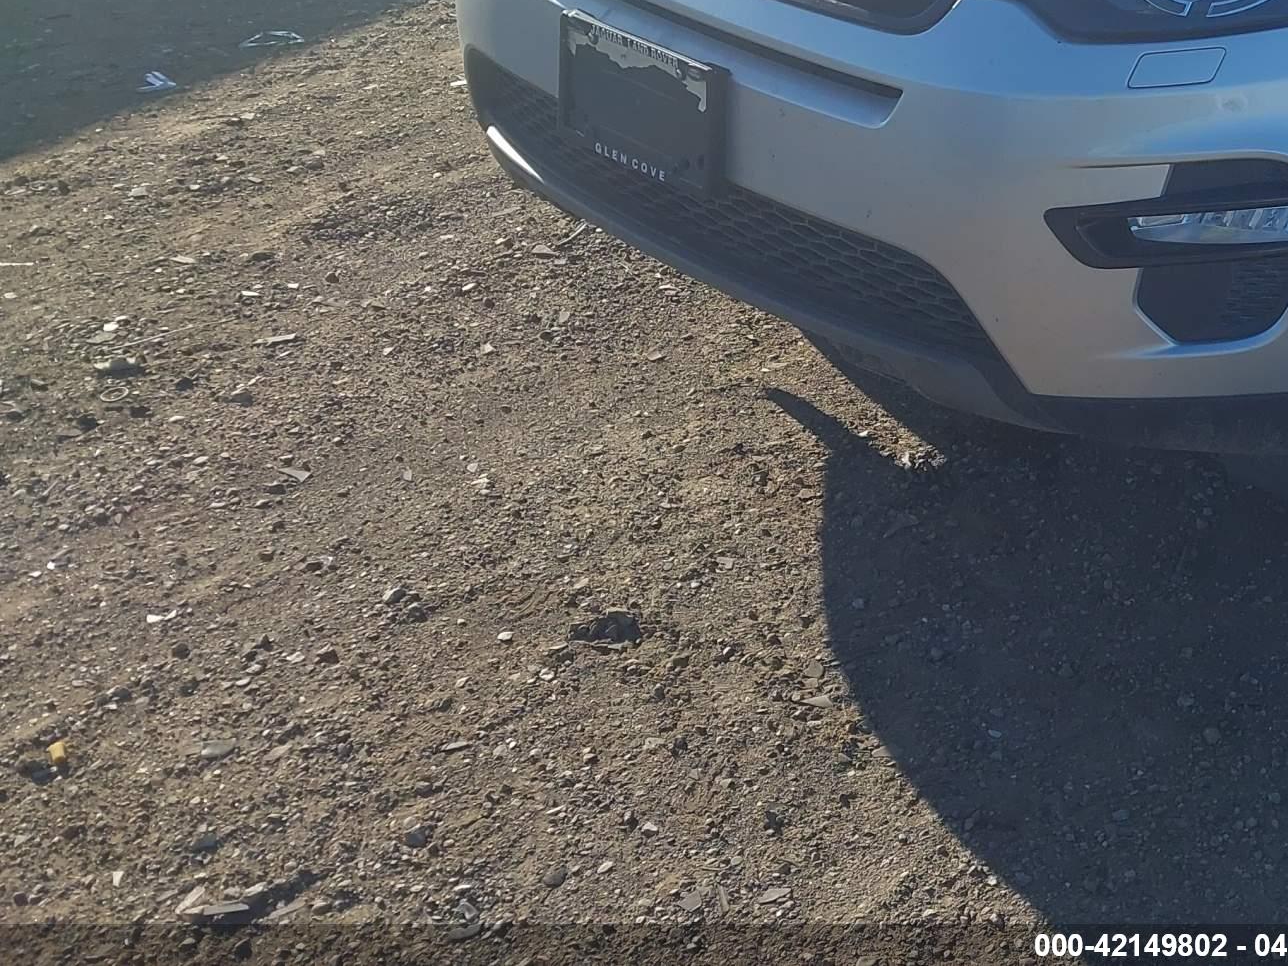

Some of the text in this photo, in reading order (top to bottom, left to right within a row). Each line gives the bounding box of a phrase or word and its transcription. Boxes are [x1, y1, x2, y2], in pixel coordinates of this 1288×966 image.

[590, 24, 679, 68] JAGUAR LAND ROVER
[595, 142, 665, 182] GLEN COVE
